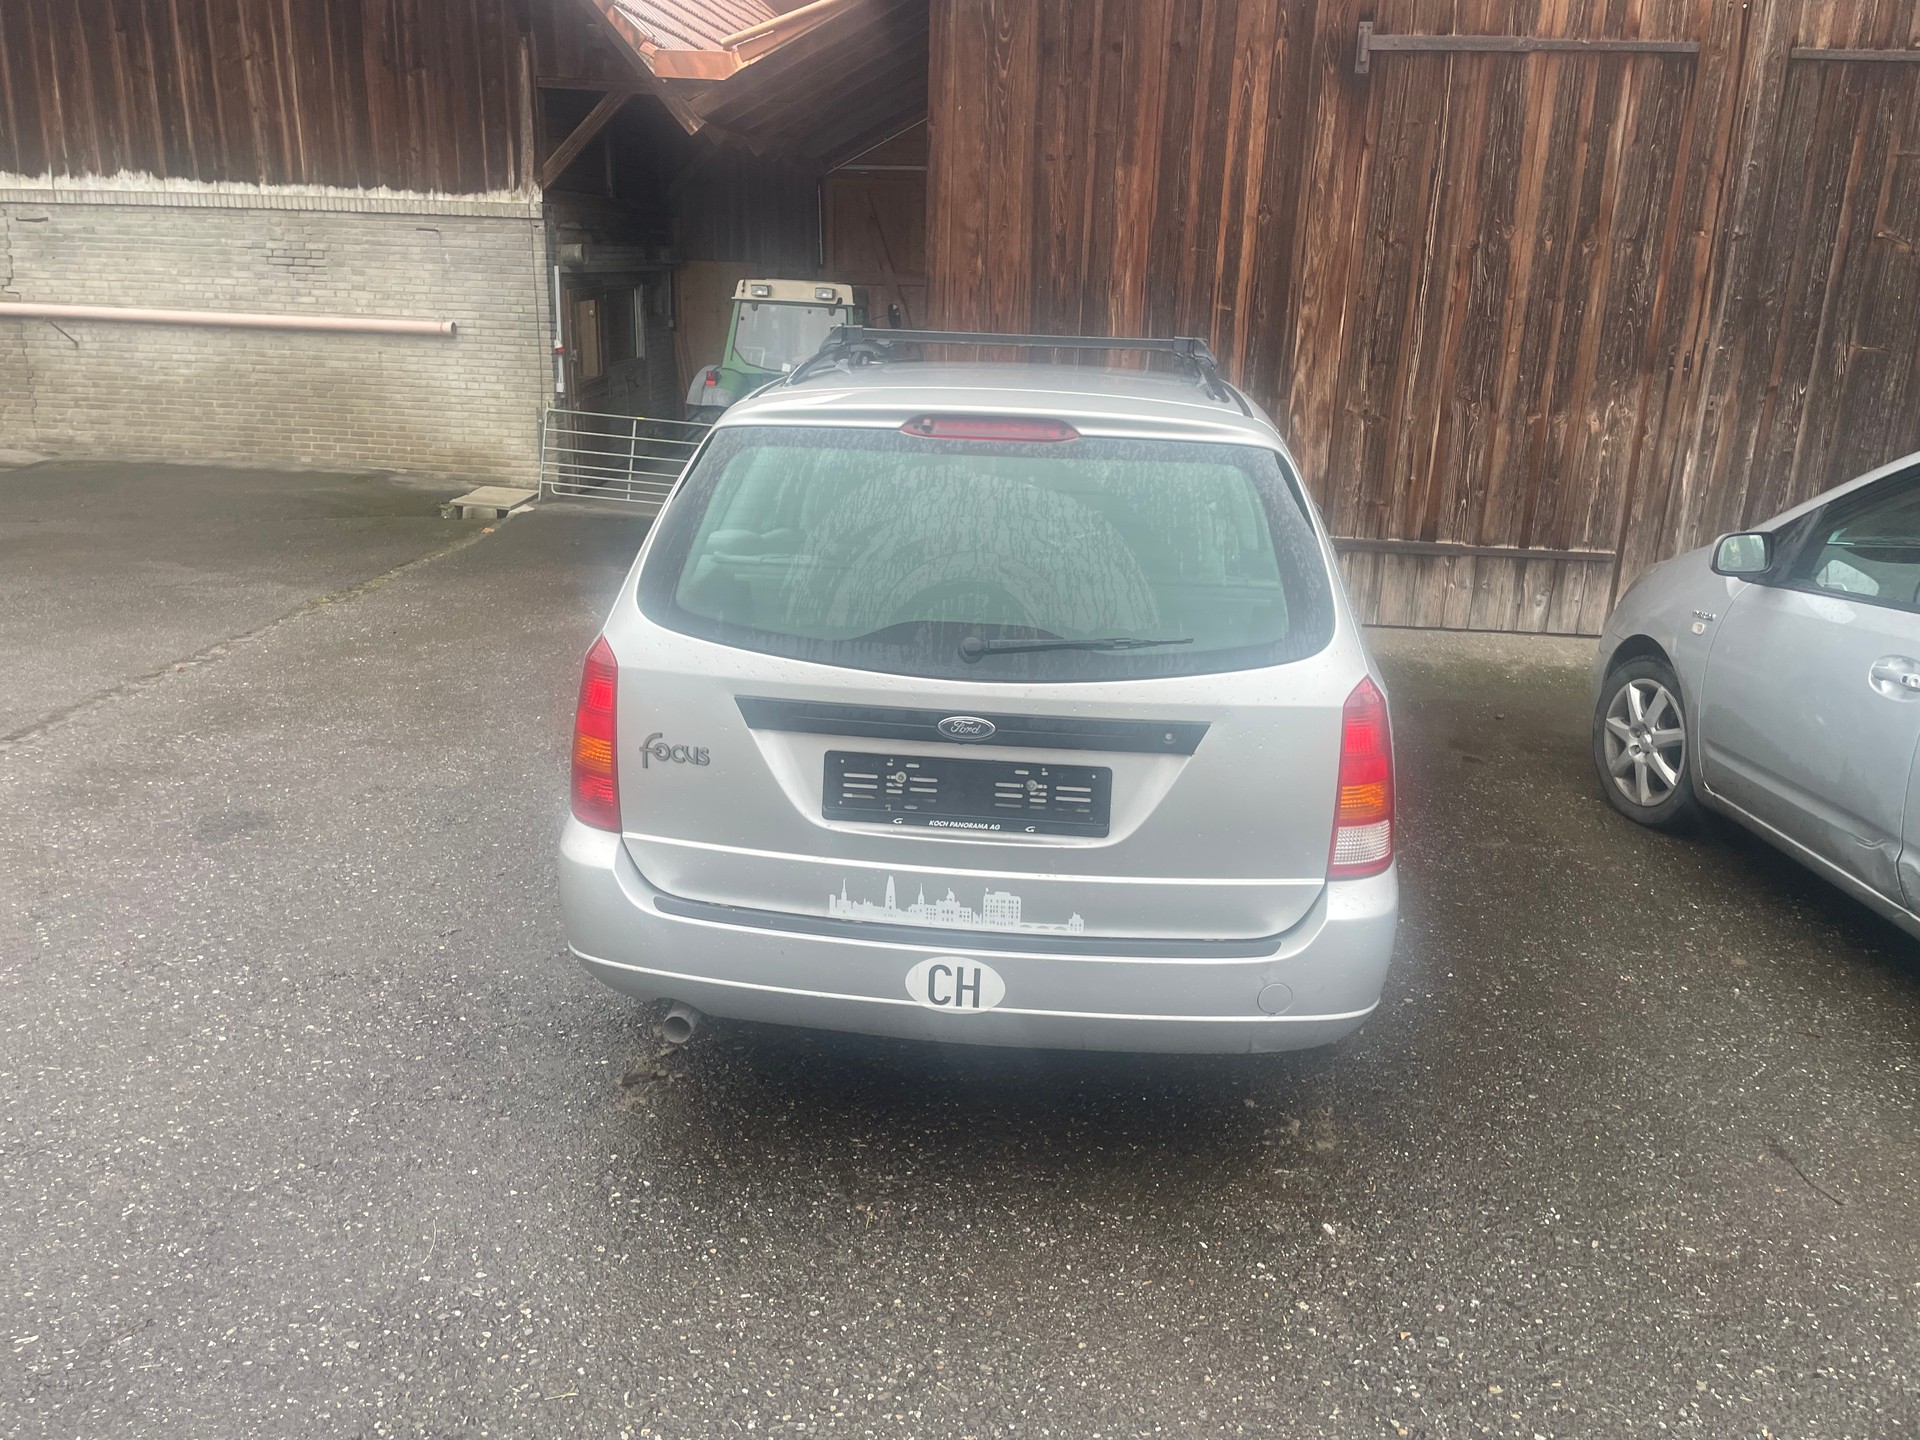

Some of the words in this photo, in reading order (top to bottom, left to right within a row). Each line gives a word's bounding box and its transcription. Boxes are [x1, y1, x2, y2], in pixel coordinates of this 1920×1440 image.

[950, 720, 982, 734] Ford
[928, 819, 949, 828] KOCH
[949, 821, 988, 830] PANORAMA
[928, 964, 981, 1009] CH
